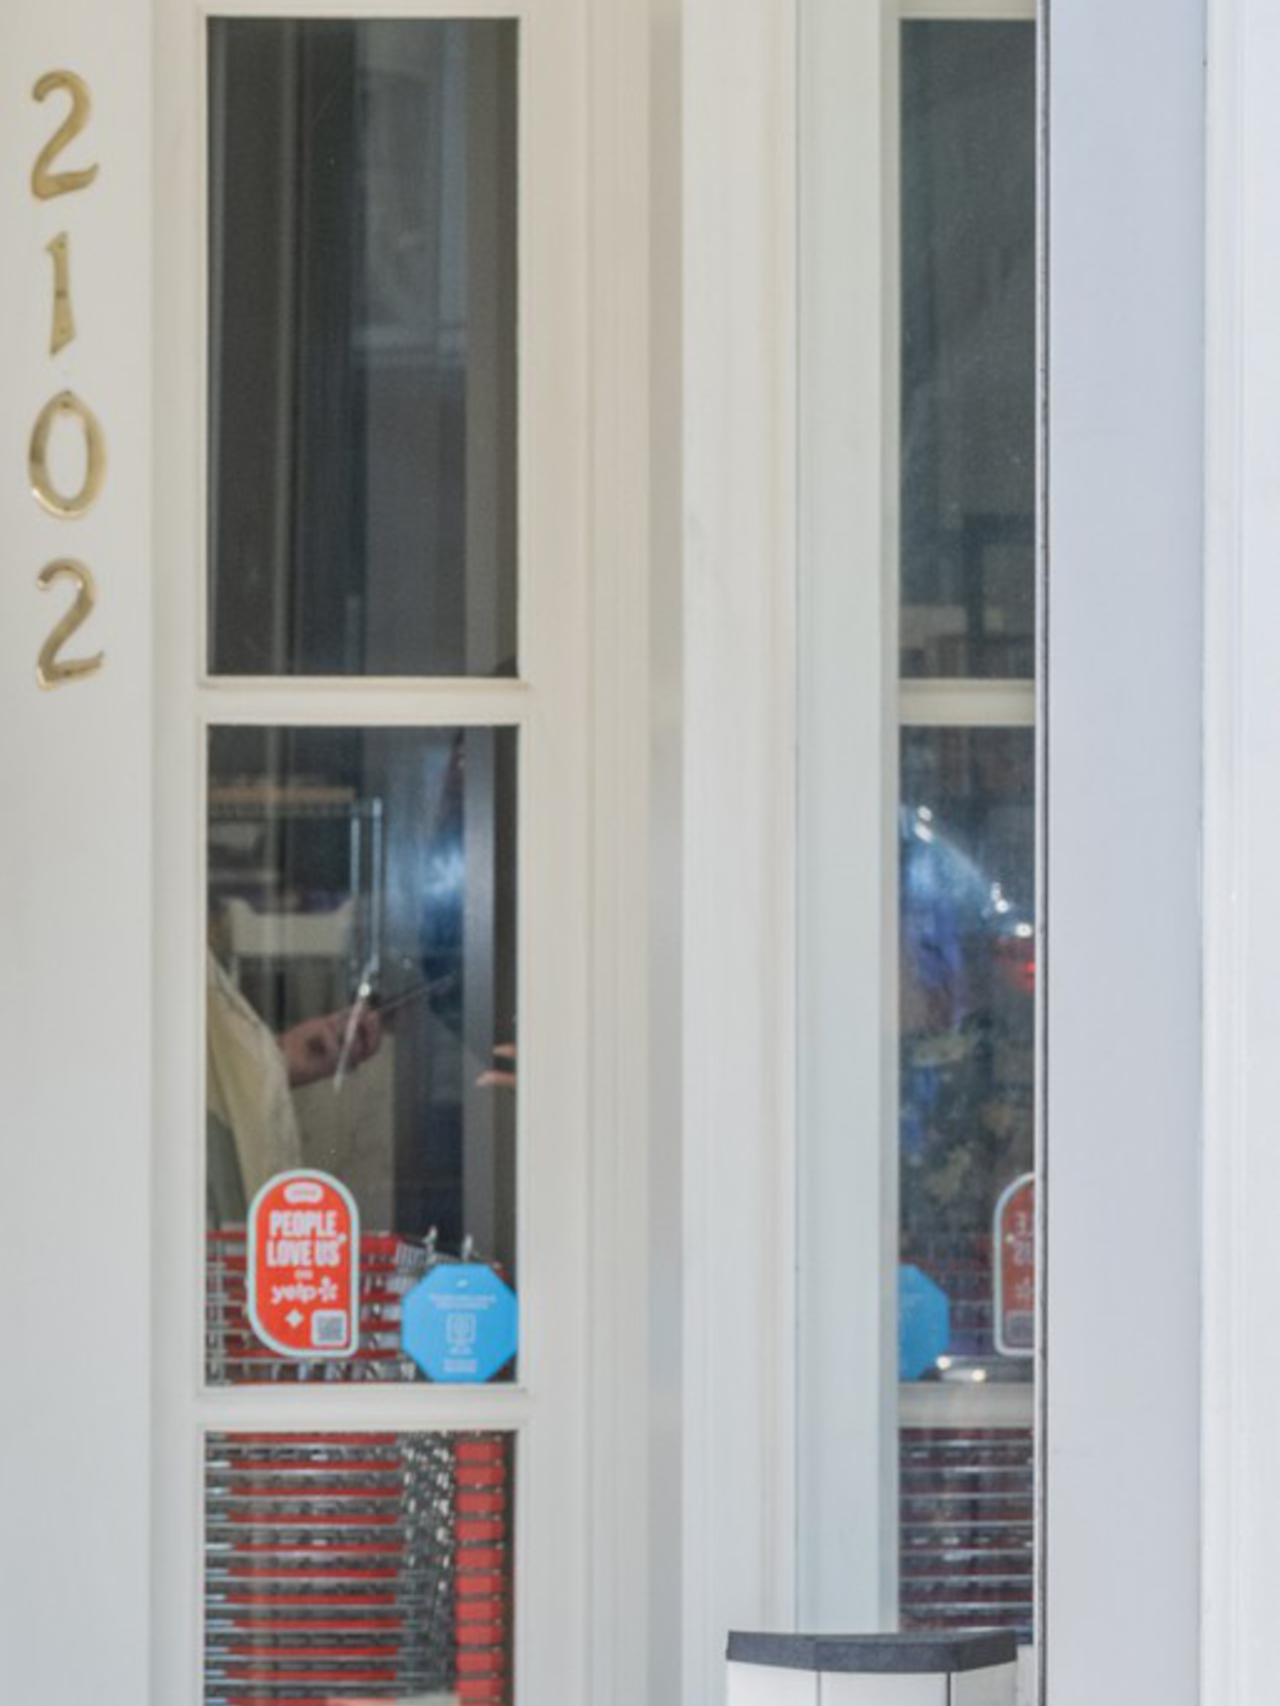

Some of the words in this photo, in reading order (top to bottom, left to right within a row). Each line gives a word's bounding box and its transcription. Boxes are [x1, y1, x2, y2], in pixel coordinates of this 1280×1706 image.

[28, 69, 108, 690] 2102
[269, 1210, 337, 1237] PEOPLE
[266, 1241, 312, 1267] LOVE
[316, 1241, 341, 1267] US
